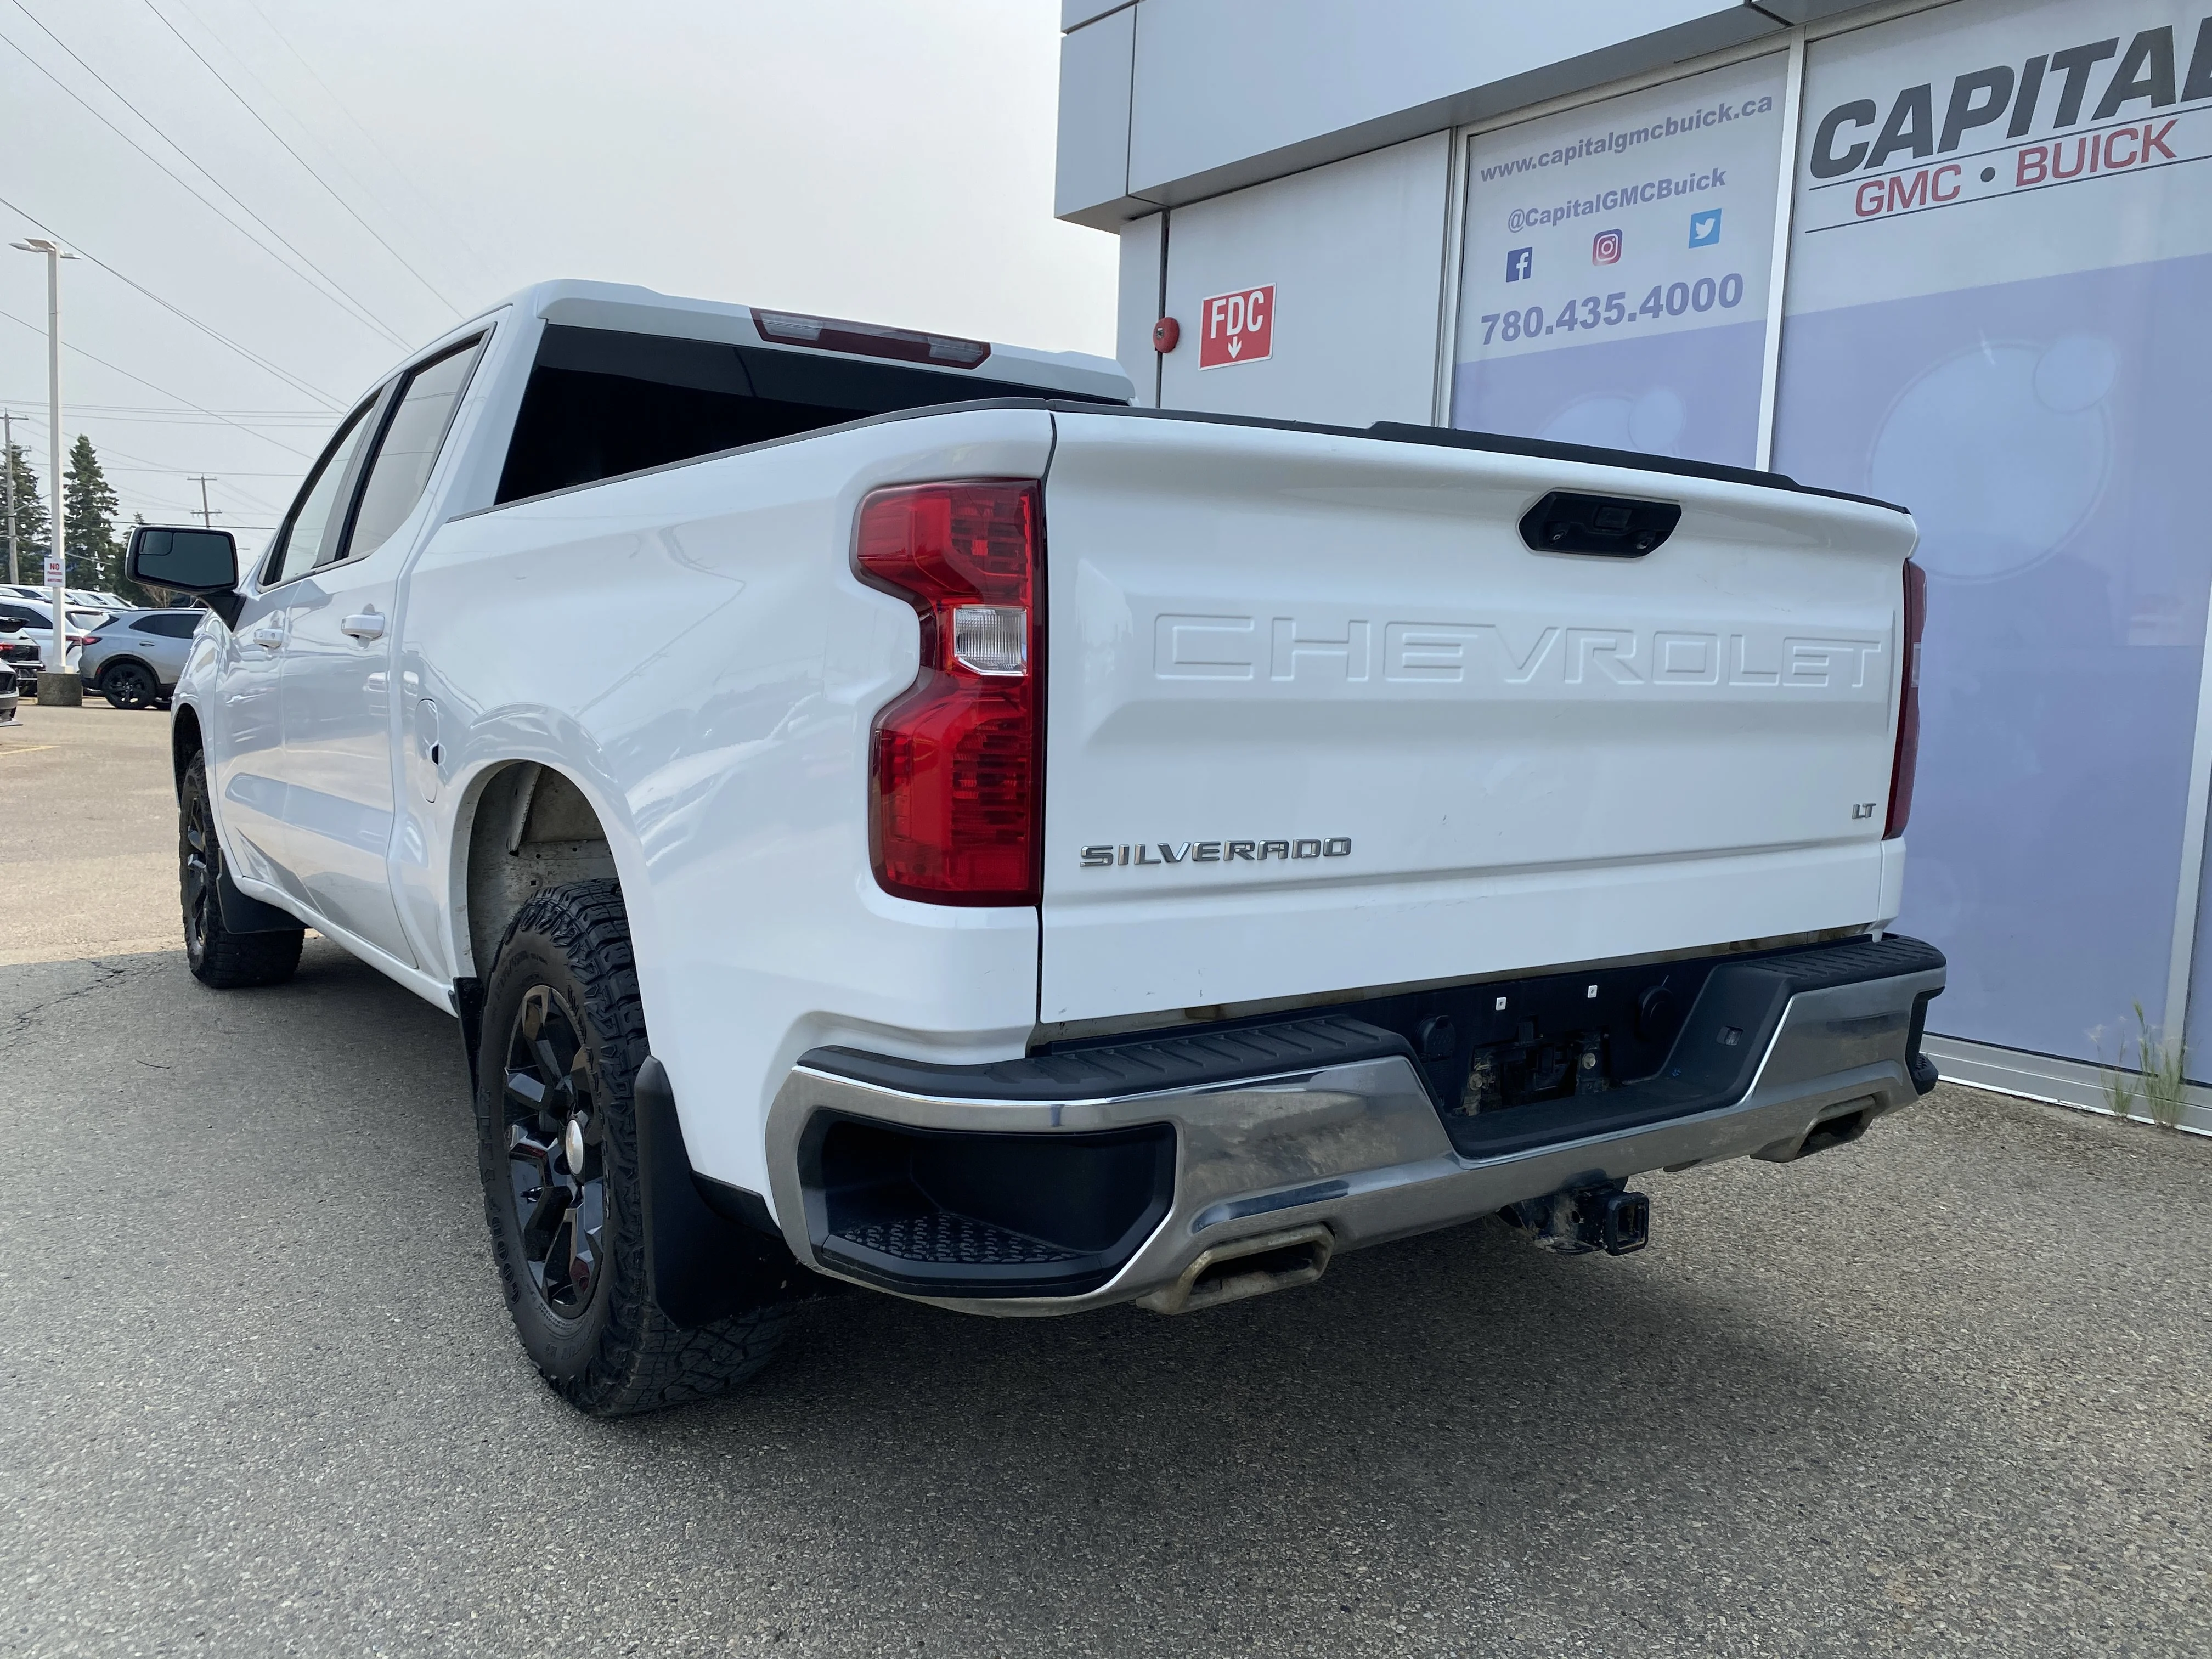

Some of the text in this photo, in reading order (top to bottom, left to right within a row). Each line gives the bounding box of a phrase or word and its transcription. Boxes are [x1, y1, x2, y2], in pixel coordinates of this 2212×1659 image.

[1481, 96, 1773, 182] www.capitalgmcbuick.ca
[1855, 119, 2179, 217] GMC BUICK
[1508, 167, 1726, 233] @CapitalGMCBuick
[1210, 290, 1265, 339] FDC
[1481, 273, 1743, 345] 780.435.4000
[1153, 613, 1882, 688] CHEVROLET
[1852, 803, 1877, 820] LT
[1079, 837, 1352, 867] SILVERADO
